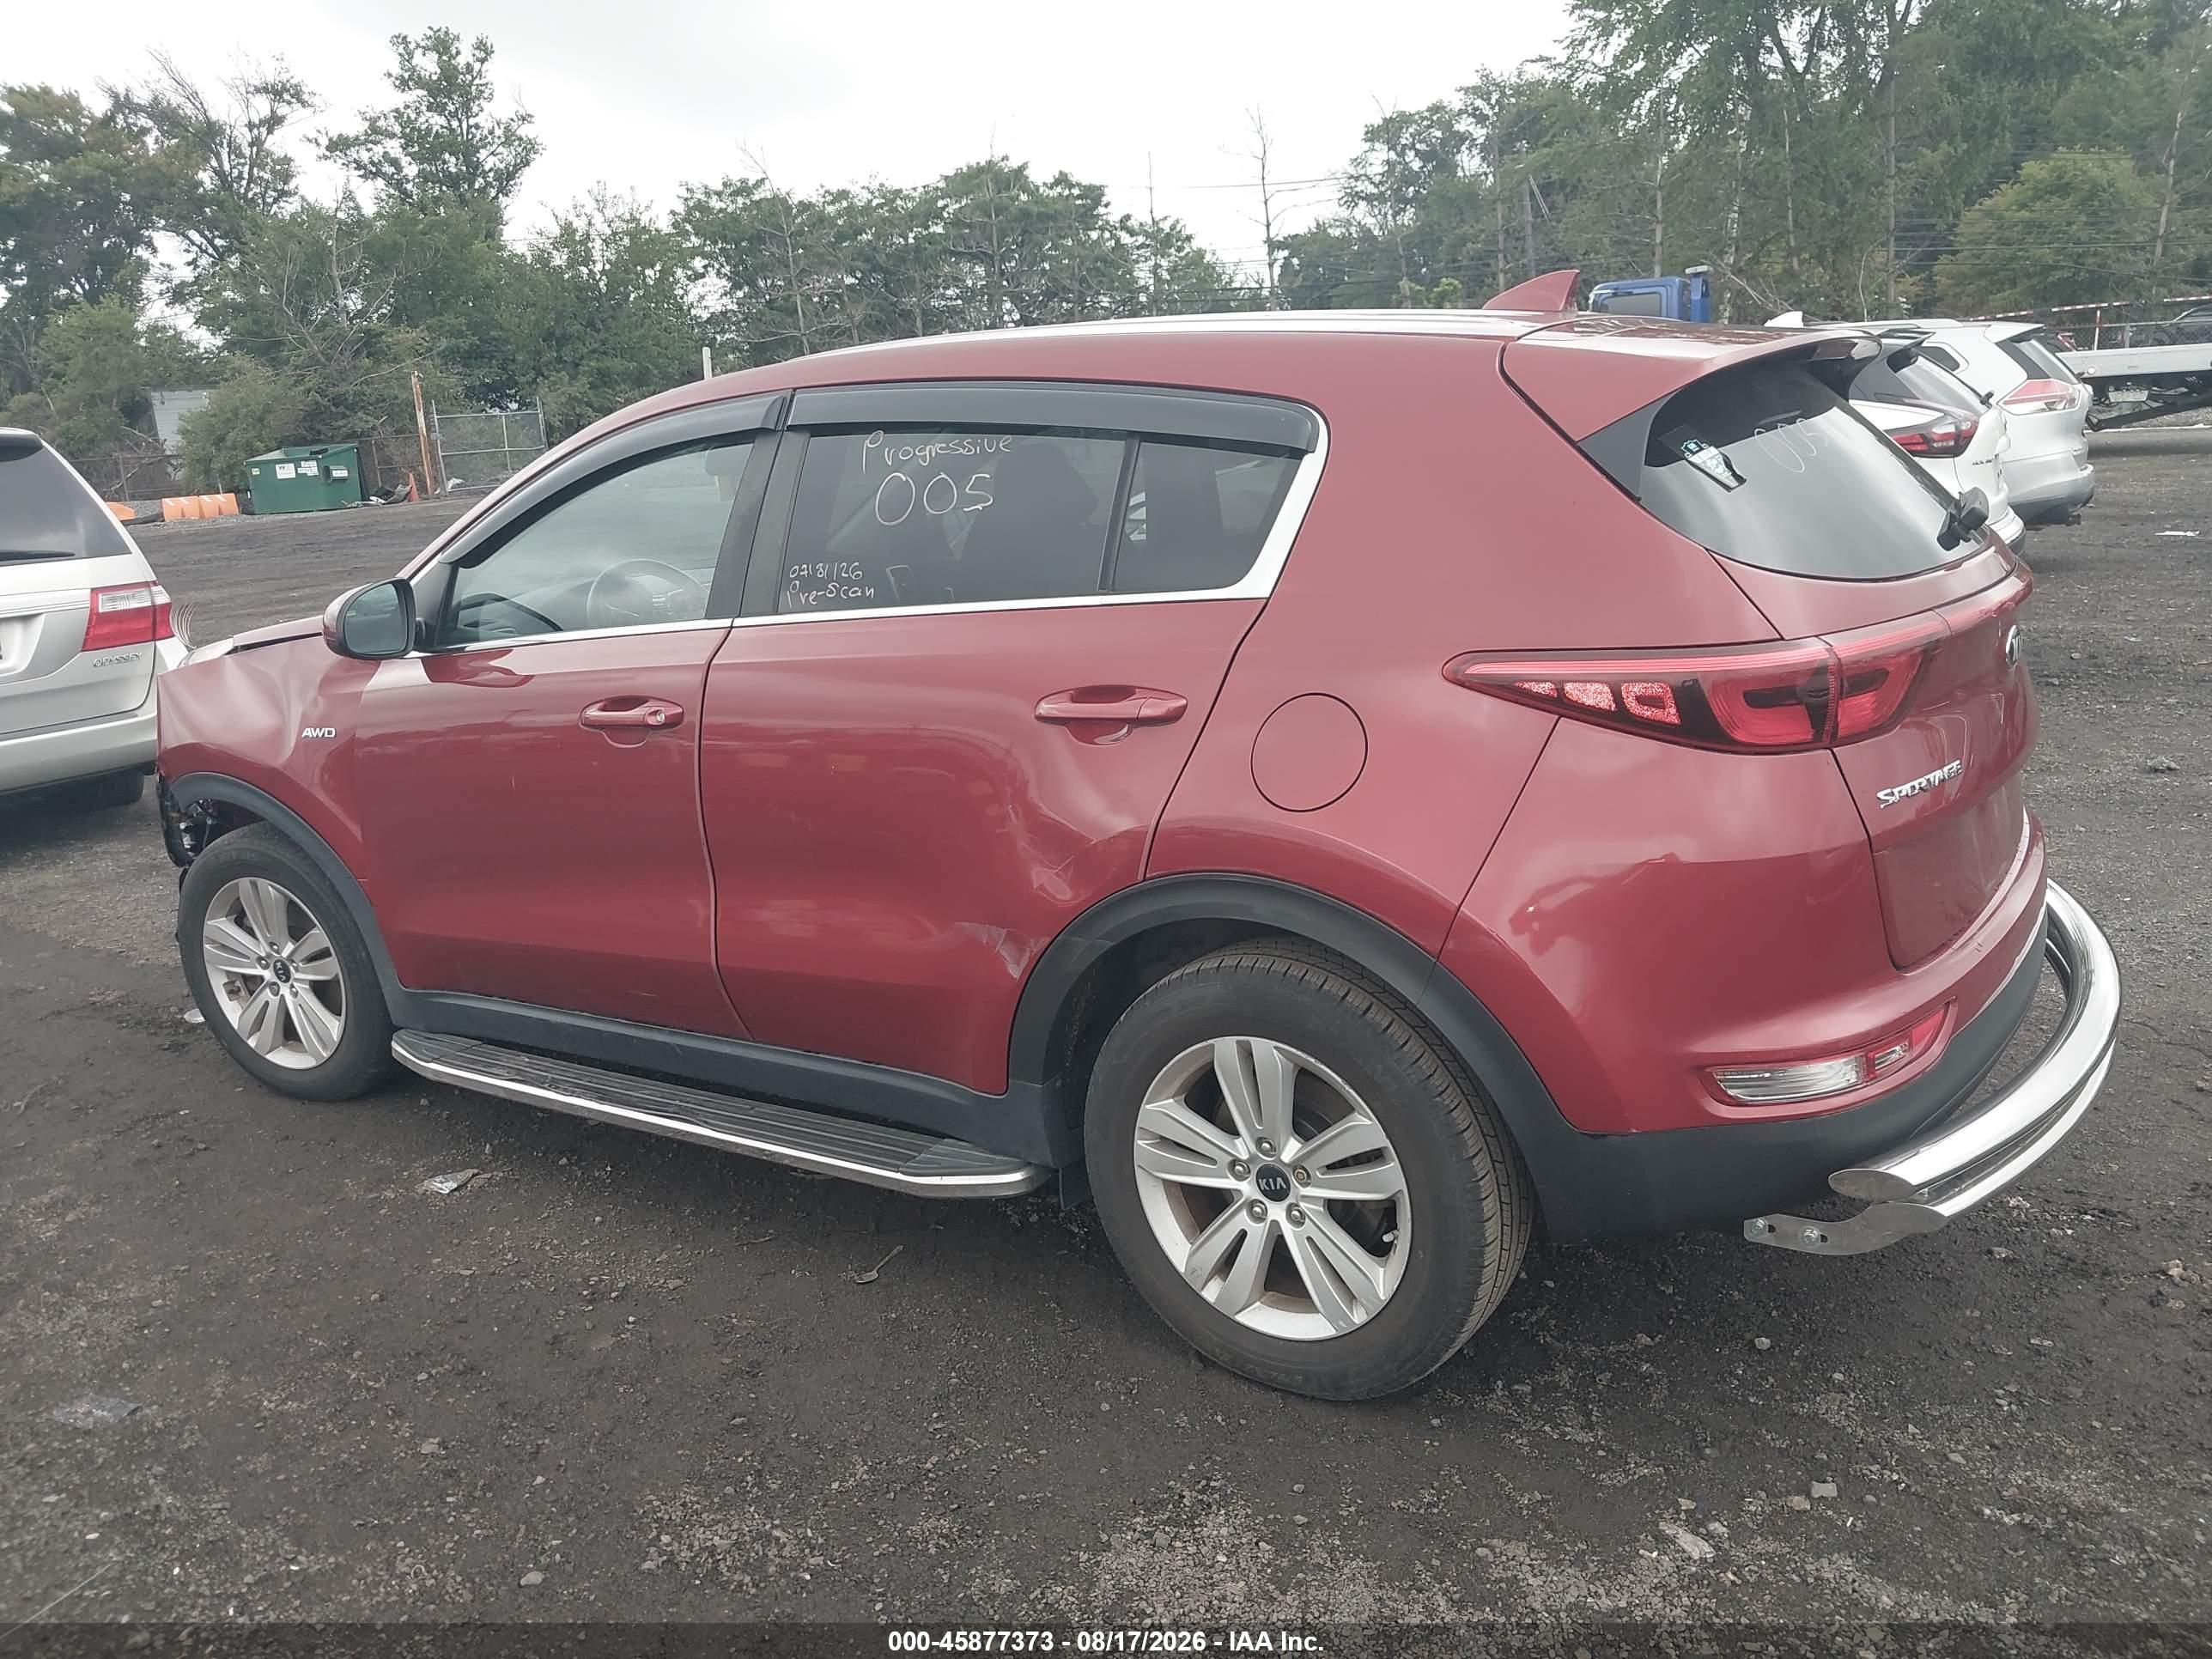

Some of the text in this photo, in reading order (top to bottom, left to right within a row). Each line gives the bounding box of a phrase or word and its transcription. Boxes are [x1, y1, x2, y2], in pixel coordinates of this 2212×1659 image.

[862, 430, 1012, 474] Progressive
[874, 471, 994, 526] 005
[787, 580, 875, 610] Pre-Scan
[93, 652, 143, 668] ODYSSEY
[301, 727, 337, 738] AWD
[1876, 759, 1963, 809] SPORTAGE
[1258, 1176, 1287, 1190] KIA
